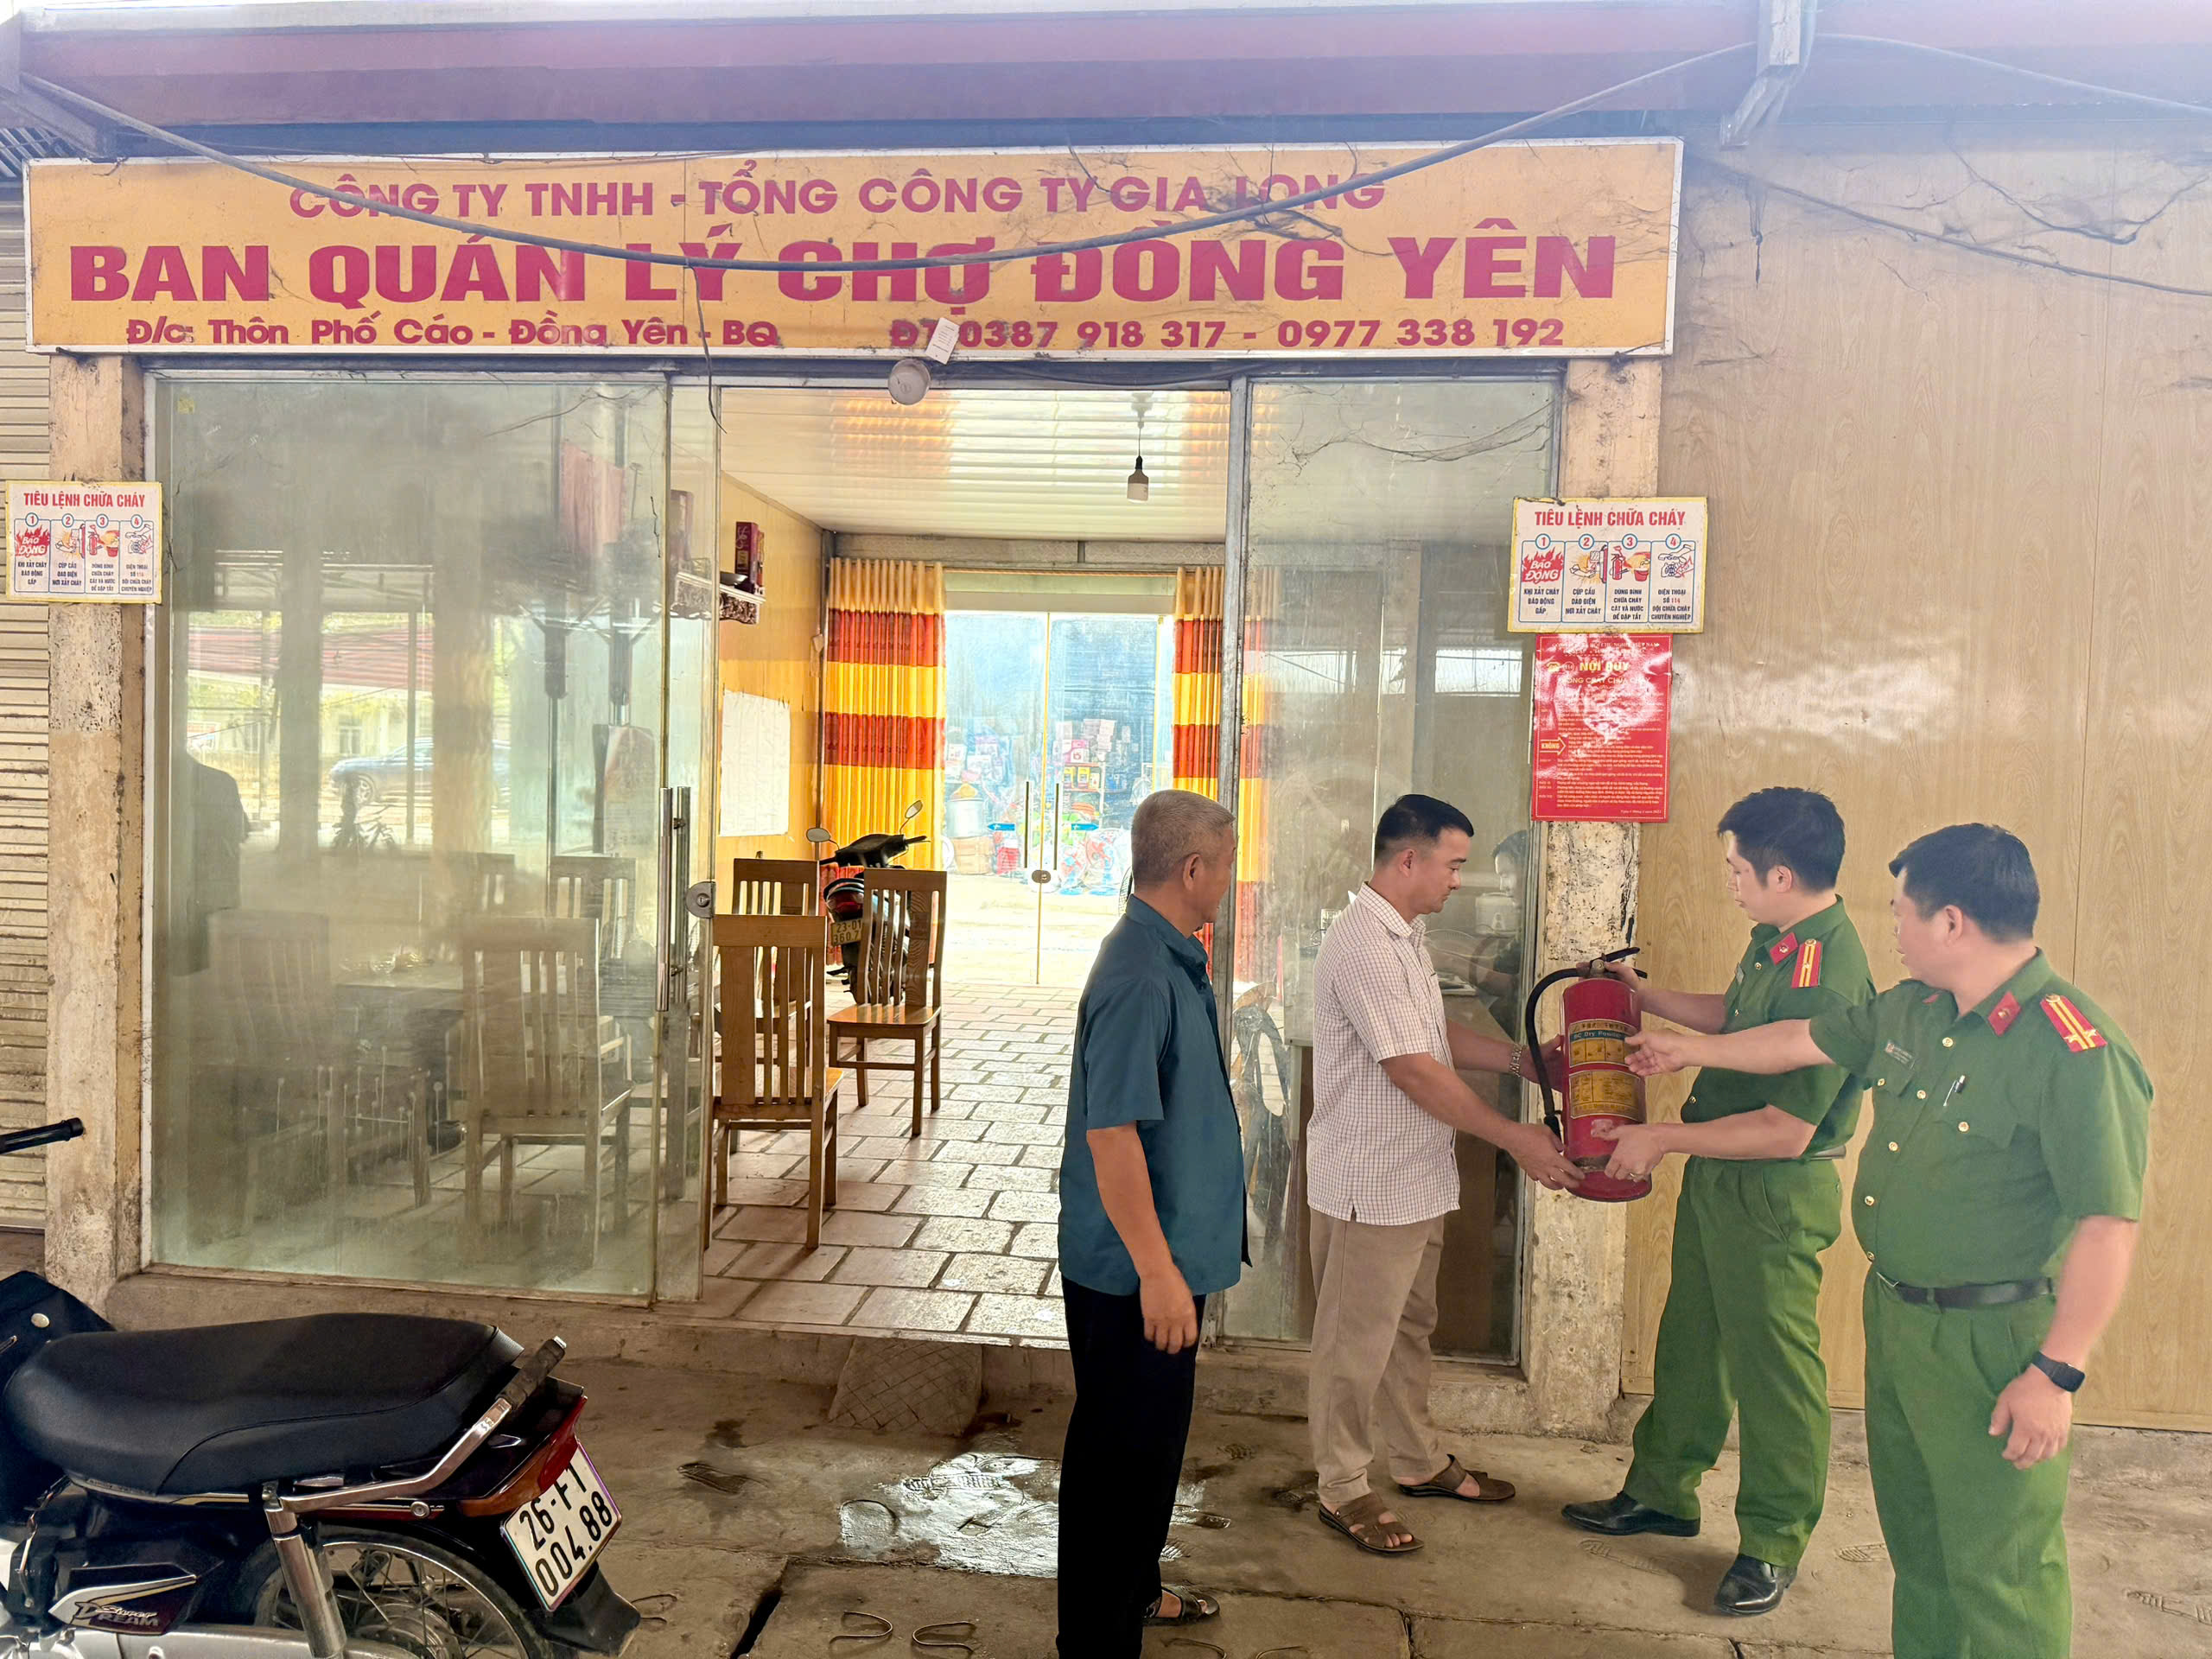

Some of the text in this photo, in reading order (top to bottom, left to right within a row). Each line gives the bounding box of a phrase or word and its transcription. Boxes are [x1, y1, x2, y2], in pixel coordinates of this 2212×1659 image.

[289, 174, 439, 218] CÔNG
[453, 183, 508, 218] TY
[524, 181, 654, 216] TNHH
[698, 160, 838, 215] TỔNG
[858, 168, 1023, 213] CÔNG
[1040, 175, 1098, 213] TY
[1109, 174, 1208, 212] GIA
[1236, 173, 1385, 210] LONG
[70, 245, 270, 302] BAN
[625, 223, 743, 302] LÝ
[778, 237, 996, 315] CHỢ
[1030, 220, 1344, 303] ĐỒNG
[1387, 218, 1616, 299] YÊN
[208, 316, 289, 344] Thôn
[311, 309, 382, 344] Phố
[394, 313, 474, 345] Cáo
[621, 316, 688, 345] Yên
[723, 319, 779, 346] BQ
[959, 320, 1058, 347] 0387
[1077, 321, 1144, 347] 918
[1160, 321, 1226, 347] 317
[1277, 320, 1381, 347] 0977
[1396, 318, 1476, 346] 338
[1492, 317, 1565, 346] 192
[23, 490, 145, 510] TIÊU LỆNH CHỮA CHÁY
[30, 515, 35, 524] 1
[65, 516, 71, 525] 2
[99, 517, 105, 525] 3
[1535, 508, 1686, 529] TIÊU LỆNH CHỮA CHÁY
[1541, 537, 1546, 547] 1
[1583, 537, 1589, 547] 2
[1626, 537, 1633, 546] 3
[1669, 537, 1676, 546] 4
[1525, 569, 1559, 583] ĐỘNG
[535, 1491, 613, 1597] 004.88
[74, 1601, 159, 1627] DREAM
